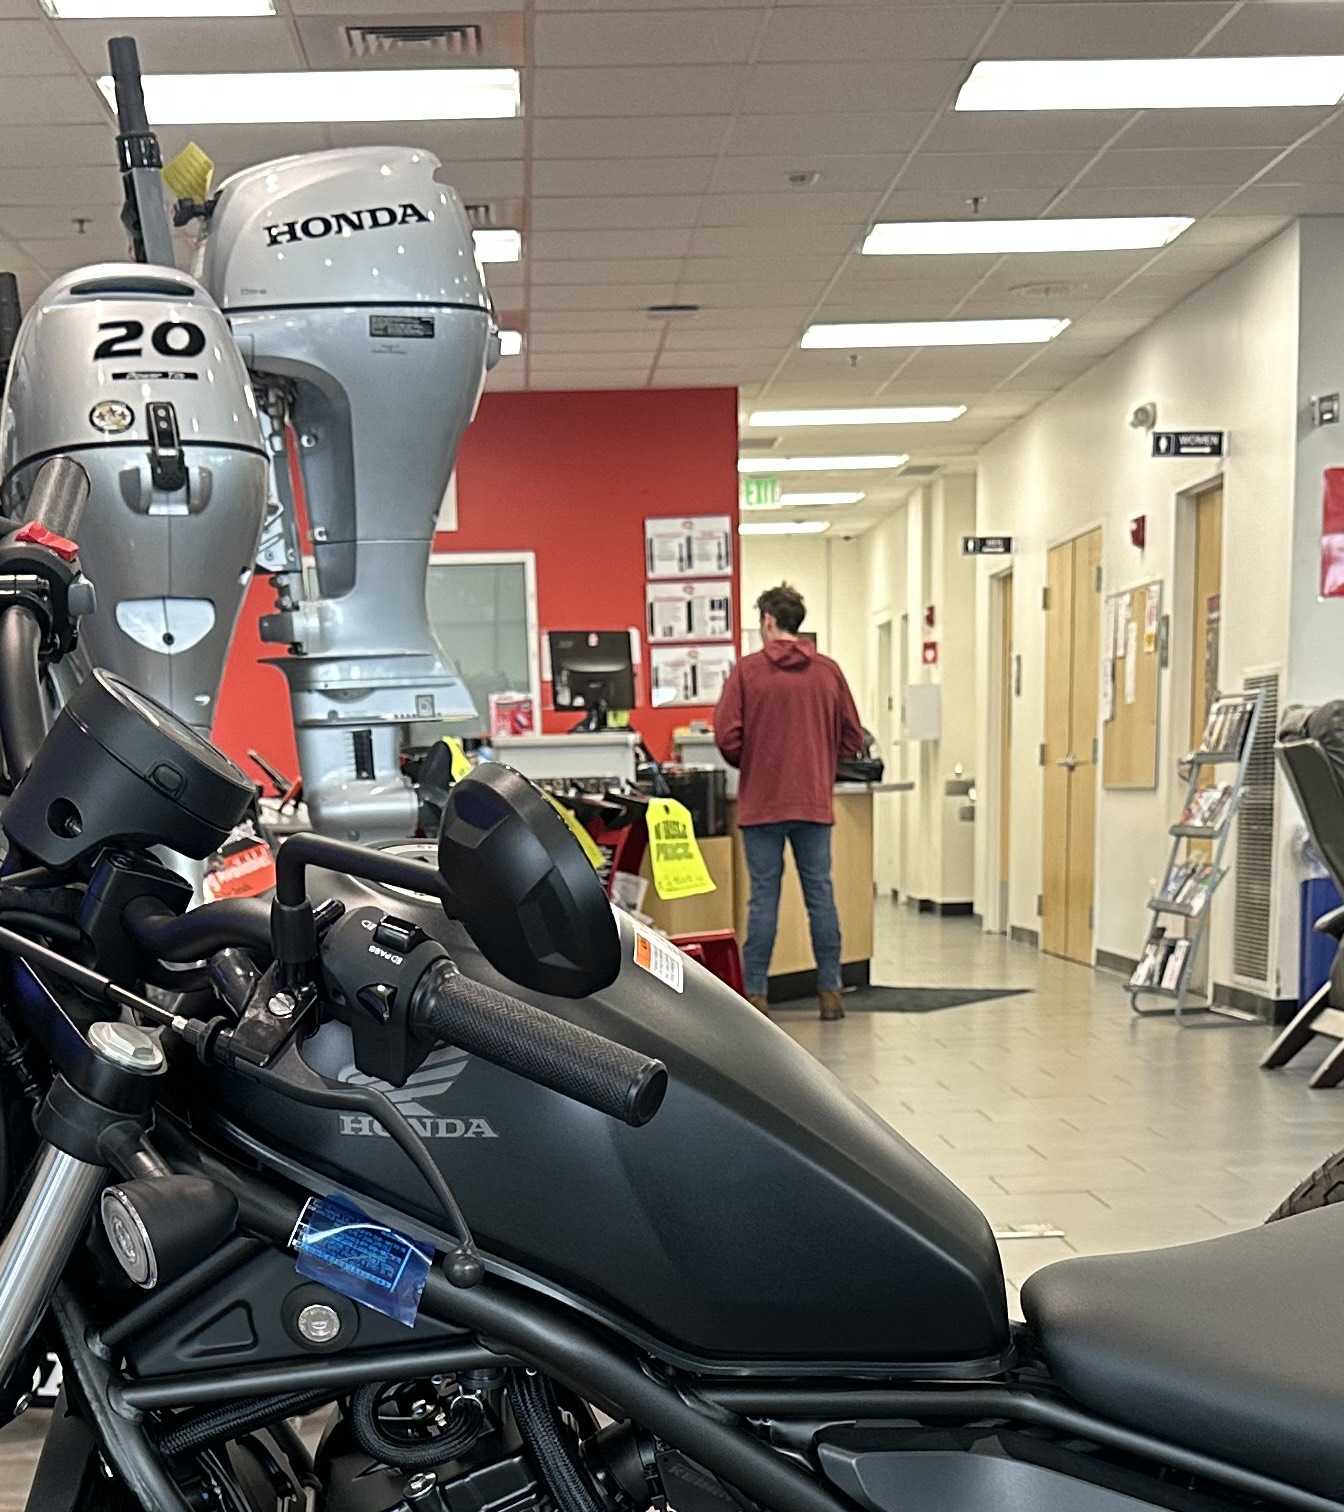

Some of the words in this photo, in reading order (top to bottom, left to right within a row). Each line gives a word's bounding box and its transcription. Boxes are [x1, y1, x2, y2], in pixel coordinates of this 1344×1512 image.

[265, 202, 433, 248] HONDA
[93, 320, 205, 360] 20
[1179, 436, 1219, 446] WOMEN
[746, 480, 778, 504] EXIT
